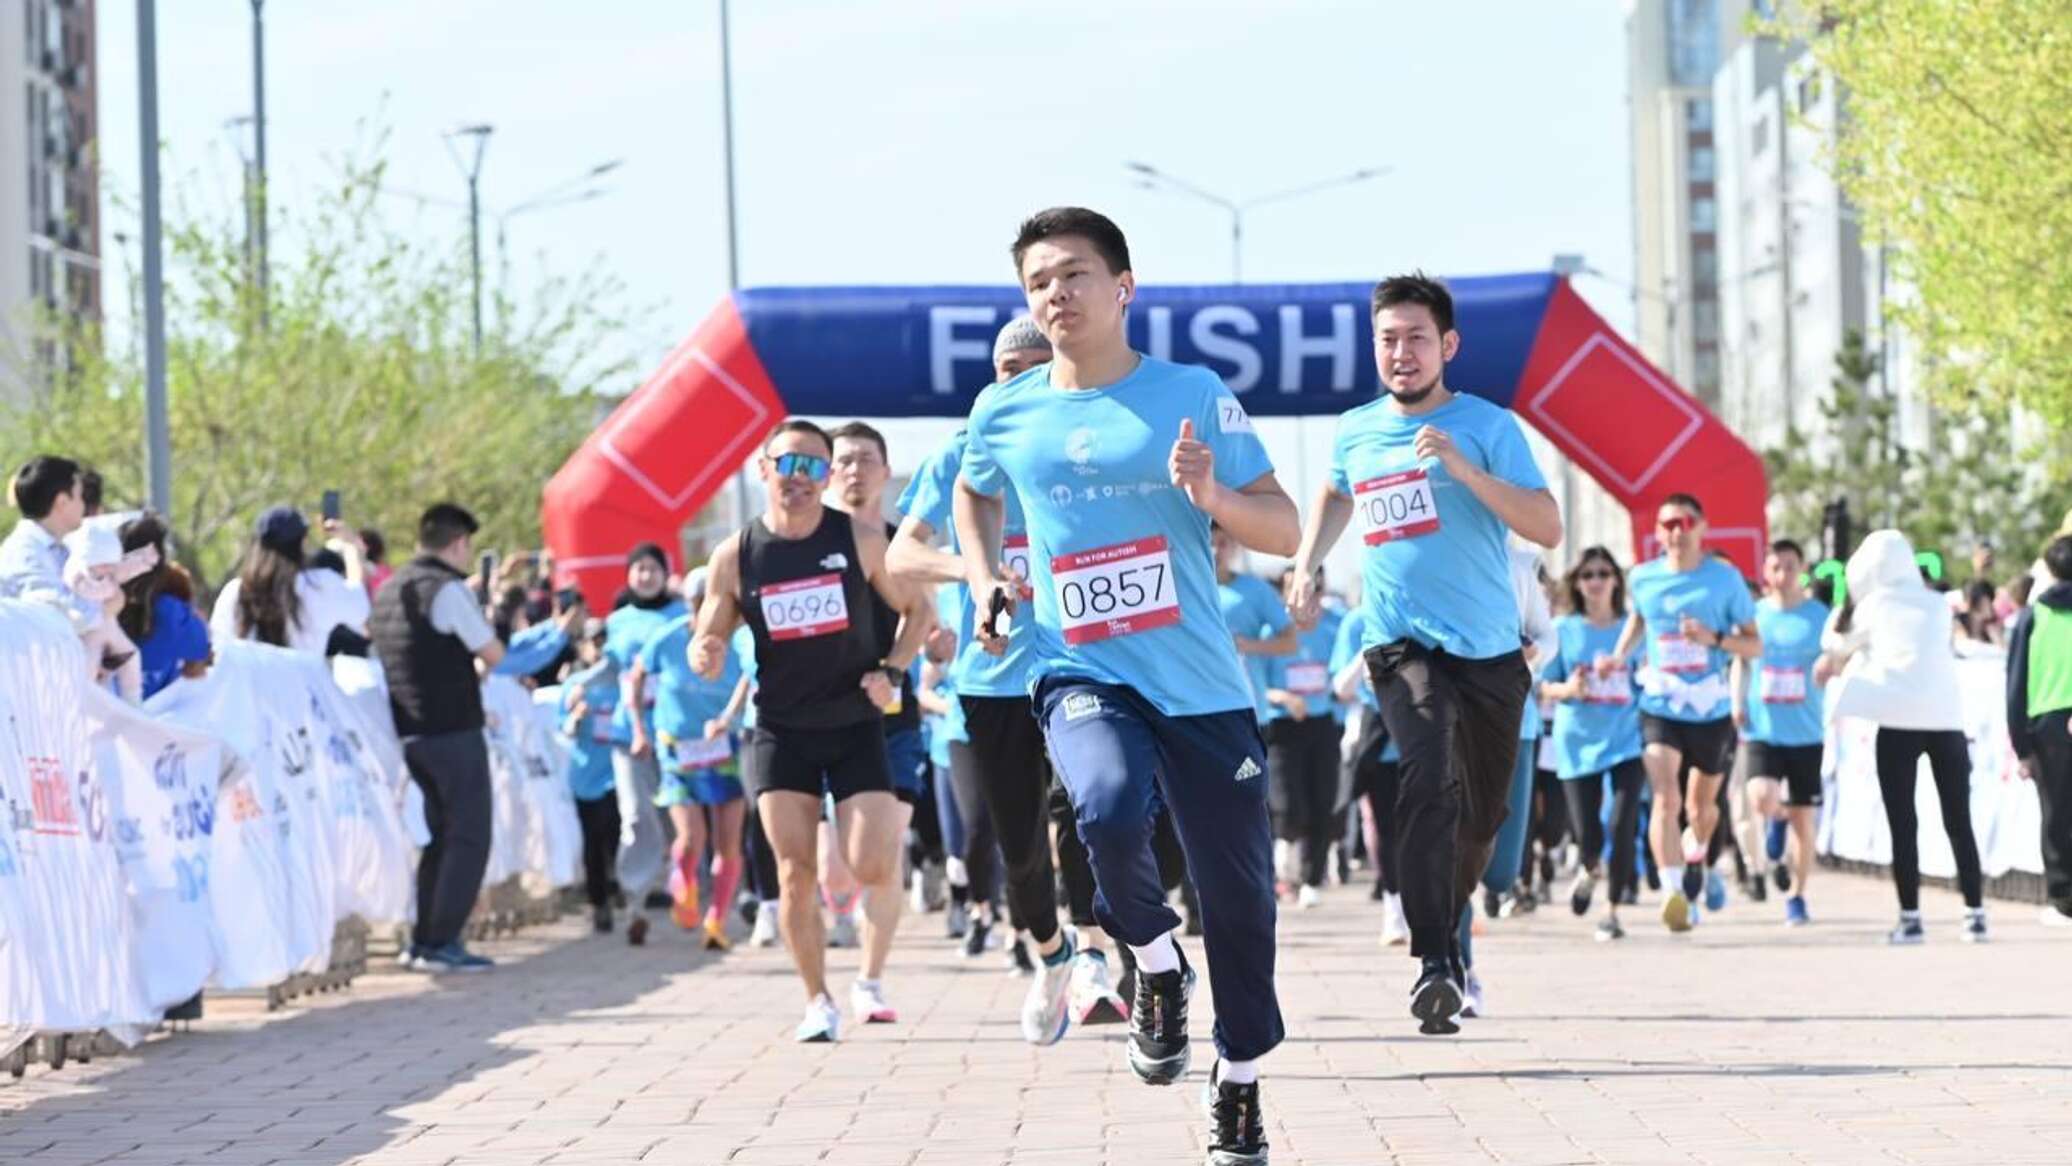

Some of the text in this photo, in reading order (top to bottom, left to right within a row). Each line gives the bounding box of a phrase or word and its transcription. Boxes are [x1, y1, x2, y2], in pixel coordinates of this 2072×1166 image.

[930, 302, 1358, 395] FISH
[1360, 488, 1429, 528] 1004
[767, 591, 842, 626] 0696
[1062, 563, 1165, 619] 0857
